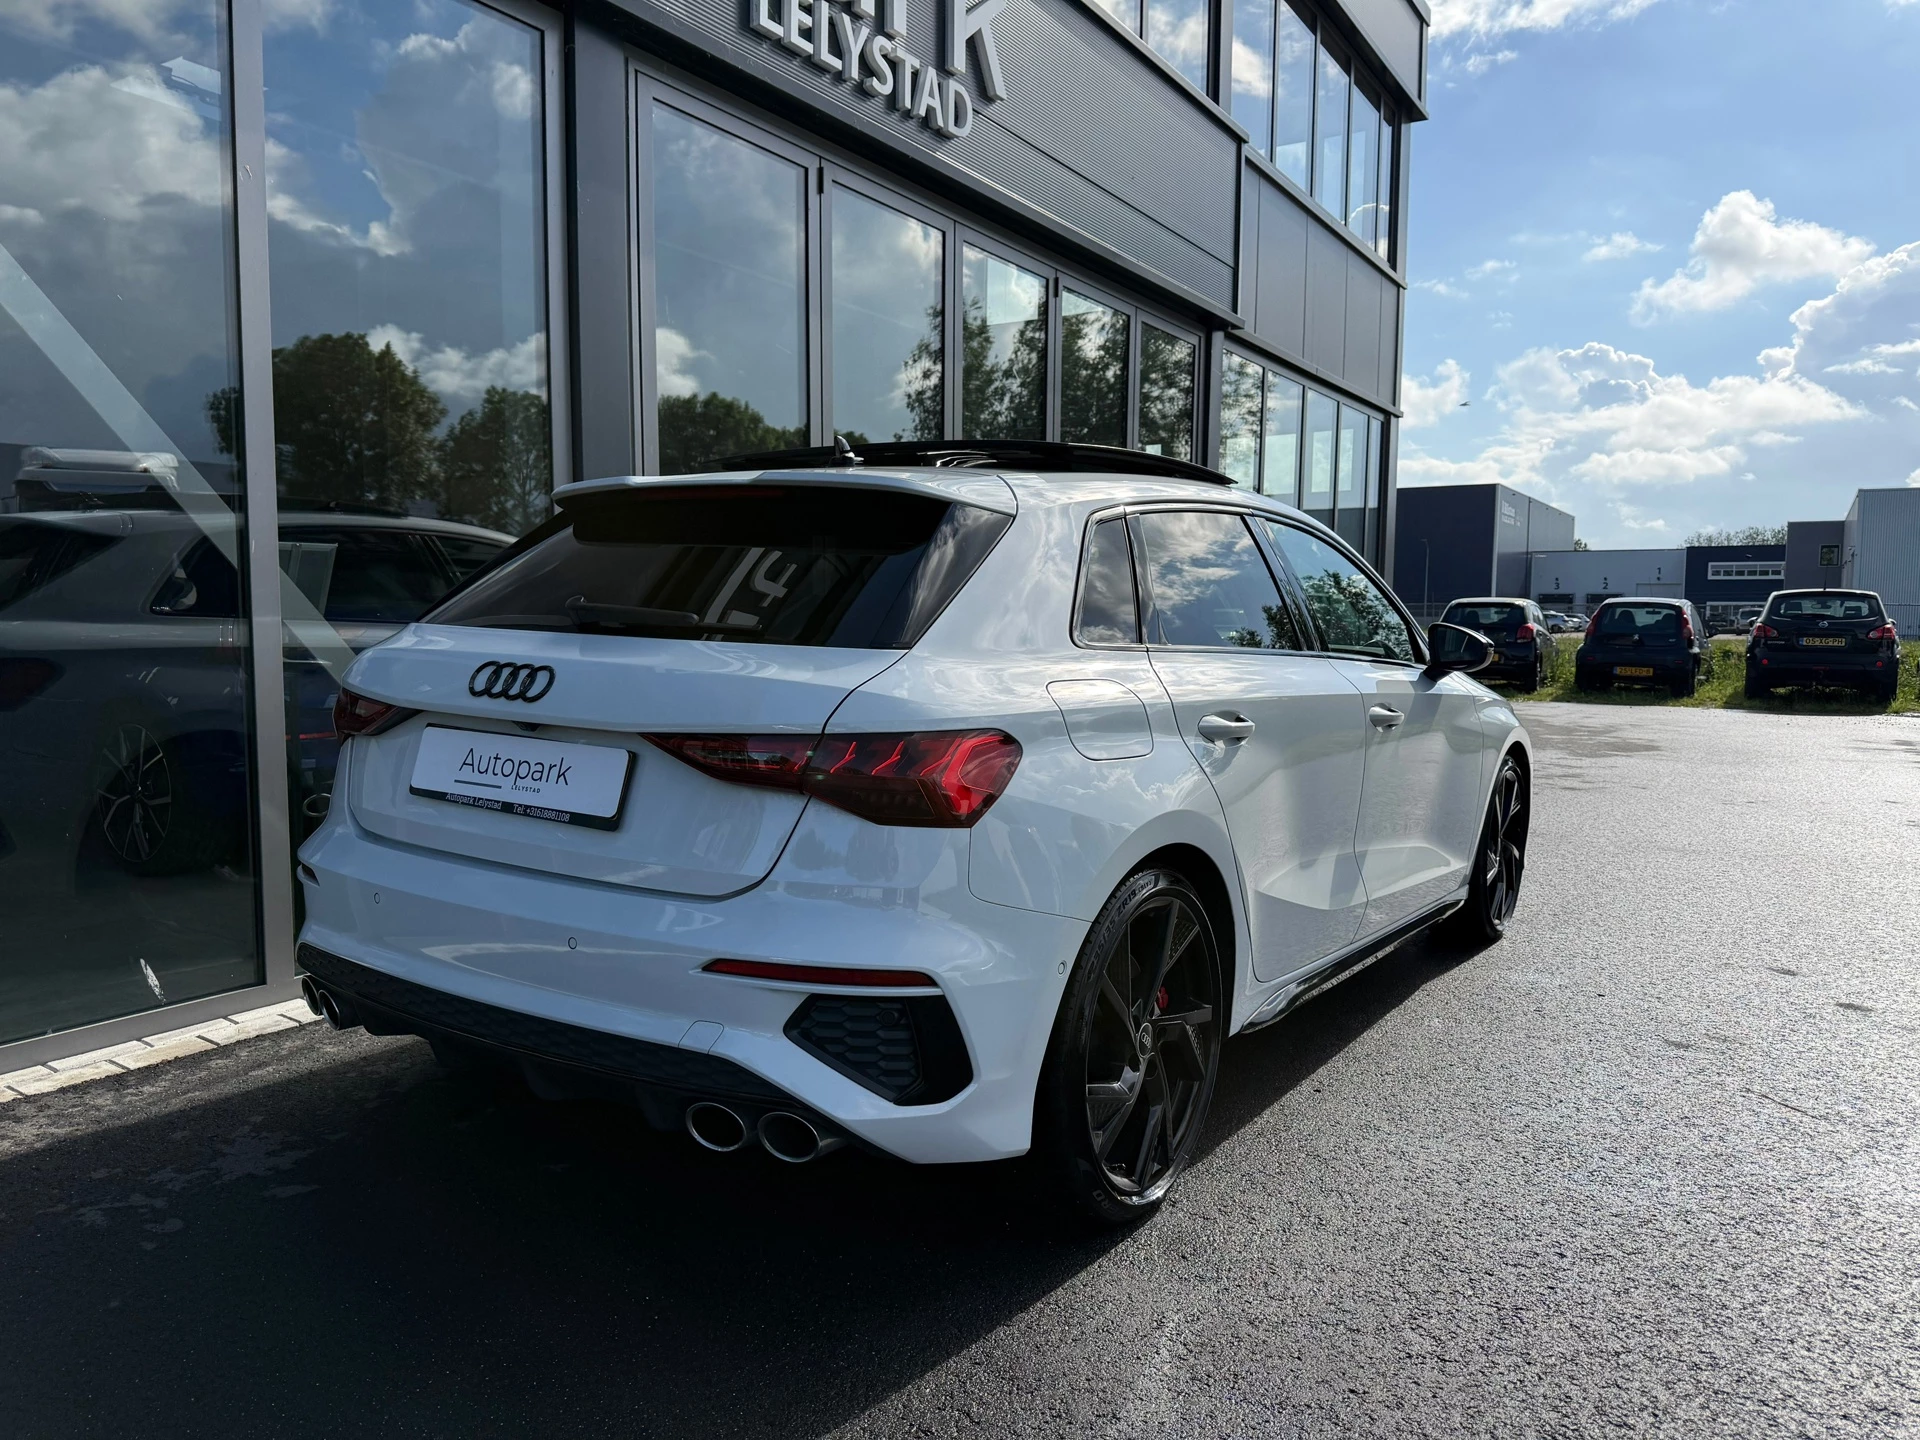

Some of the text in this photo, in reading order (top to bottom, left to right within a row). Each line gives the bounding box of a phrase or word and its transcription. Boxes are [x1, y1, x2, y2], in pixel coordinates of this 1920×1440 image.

[750, 0, 974, 139] LELYSTAD
[1656, 566, 1662, 575] 1
[1554, 582, 1561, 590] 3
[1602, 582, 1609, 590] 2
[458, 747, 572, 786] Autopark
[511, 785, 541, 794] LELYSTAD
[445, 792, 474, 806] Autopark
[474, 797, 502, 810] Lelystad
[513, 804, 526, 814] Tel:
